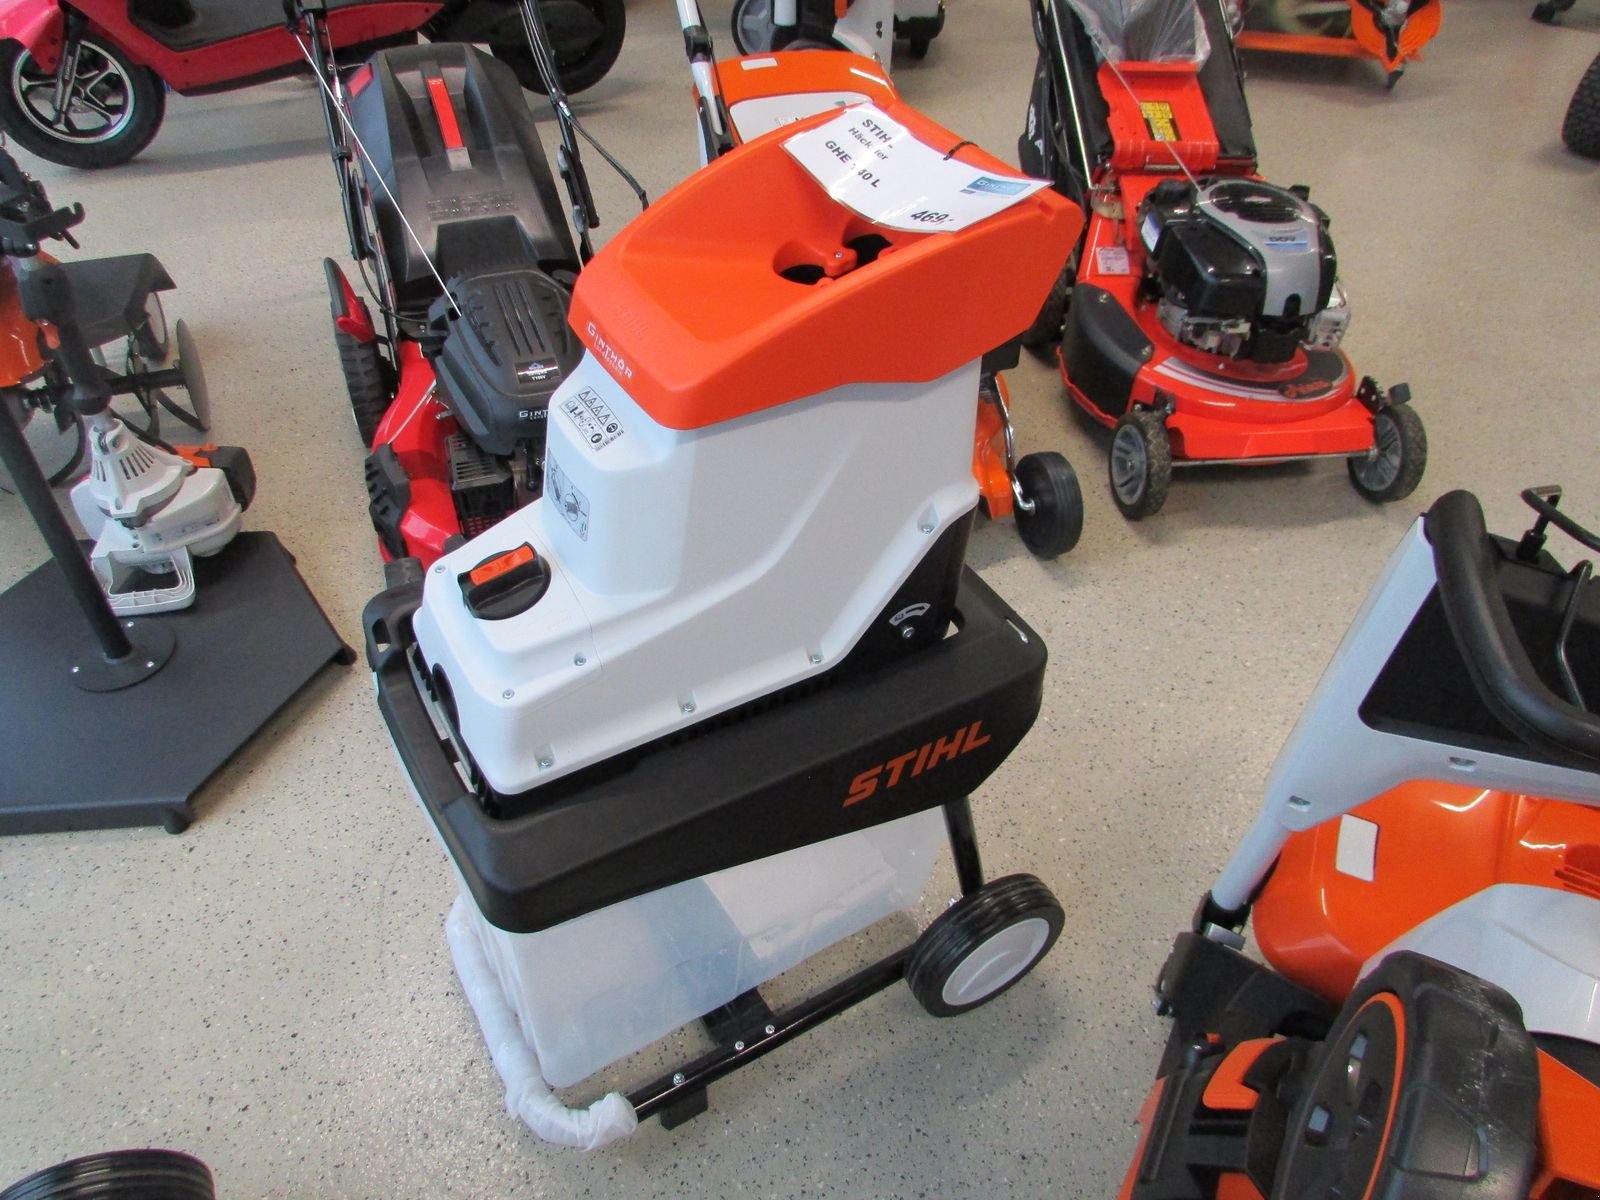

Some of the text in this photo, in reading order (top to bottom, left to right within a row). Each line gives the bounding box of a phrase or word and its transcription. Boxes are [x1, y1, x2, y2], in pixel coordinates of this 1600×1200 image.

[862, 119, 893, 149] STIH
[825, 140, 852, 164] GHE
[871, 178, 881, 188] L
[842, 720, 992, 808] STIHL
